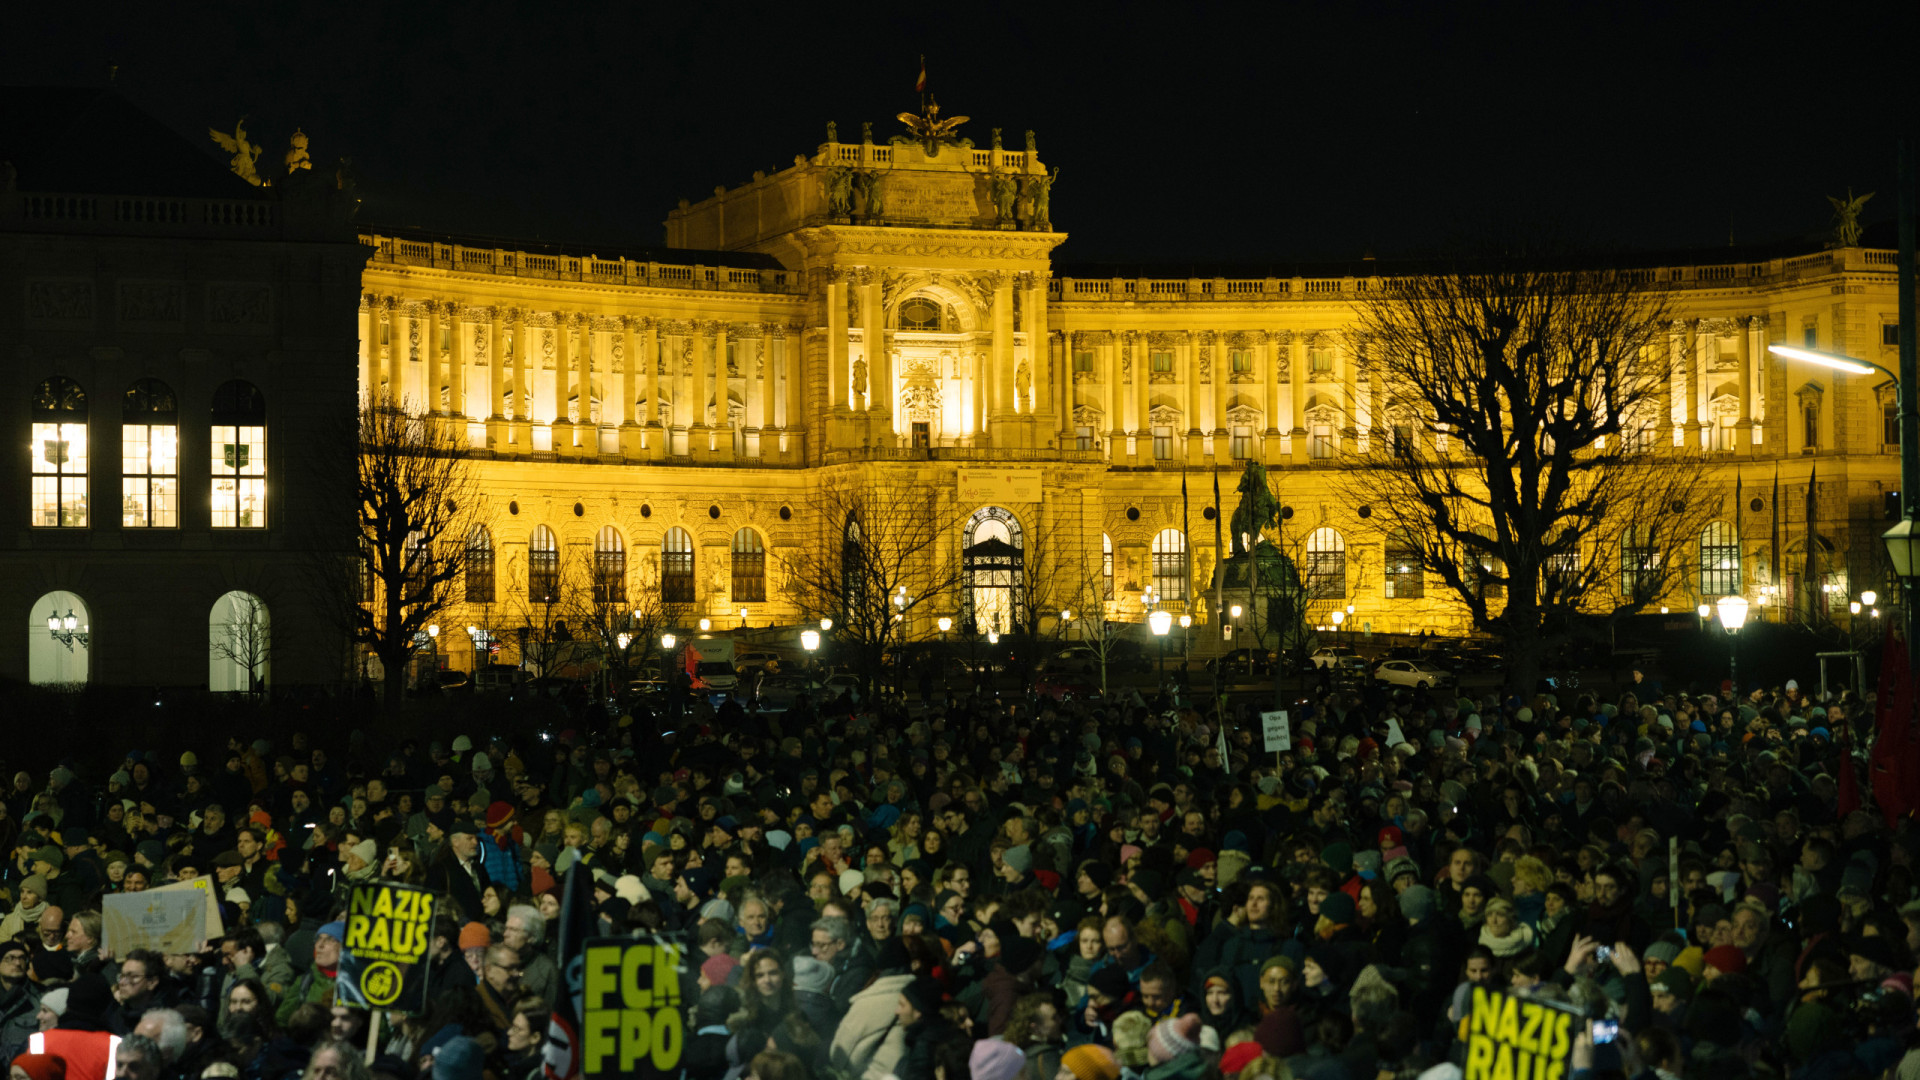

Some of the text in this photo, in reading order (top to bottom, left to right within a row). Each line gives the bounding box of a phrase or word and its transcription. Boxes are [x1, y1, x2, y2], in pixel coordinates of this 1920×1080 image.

[350, 886, 434, 923] NAZIS
[345, 914, 429, 956] RAUS
[585, 944, 681, 1009] FCK
[1471, 986, 1571, 1060] NAZIS
